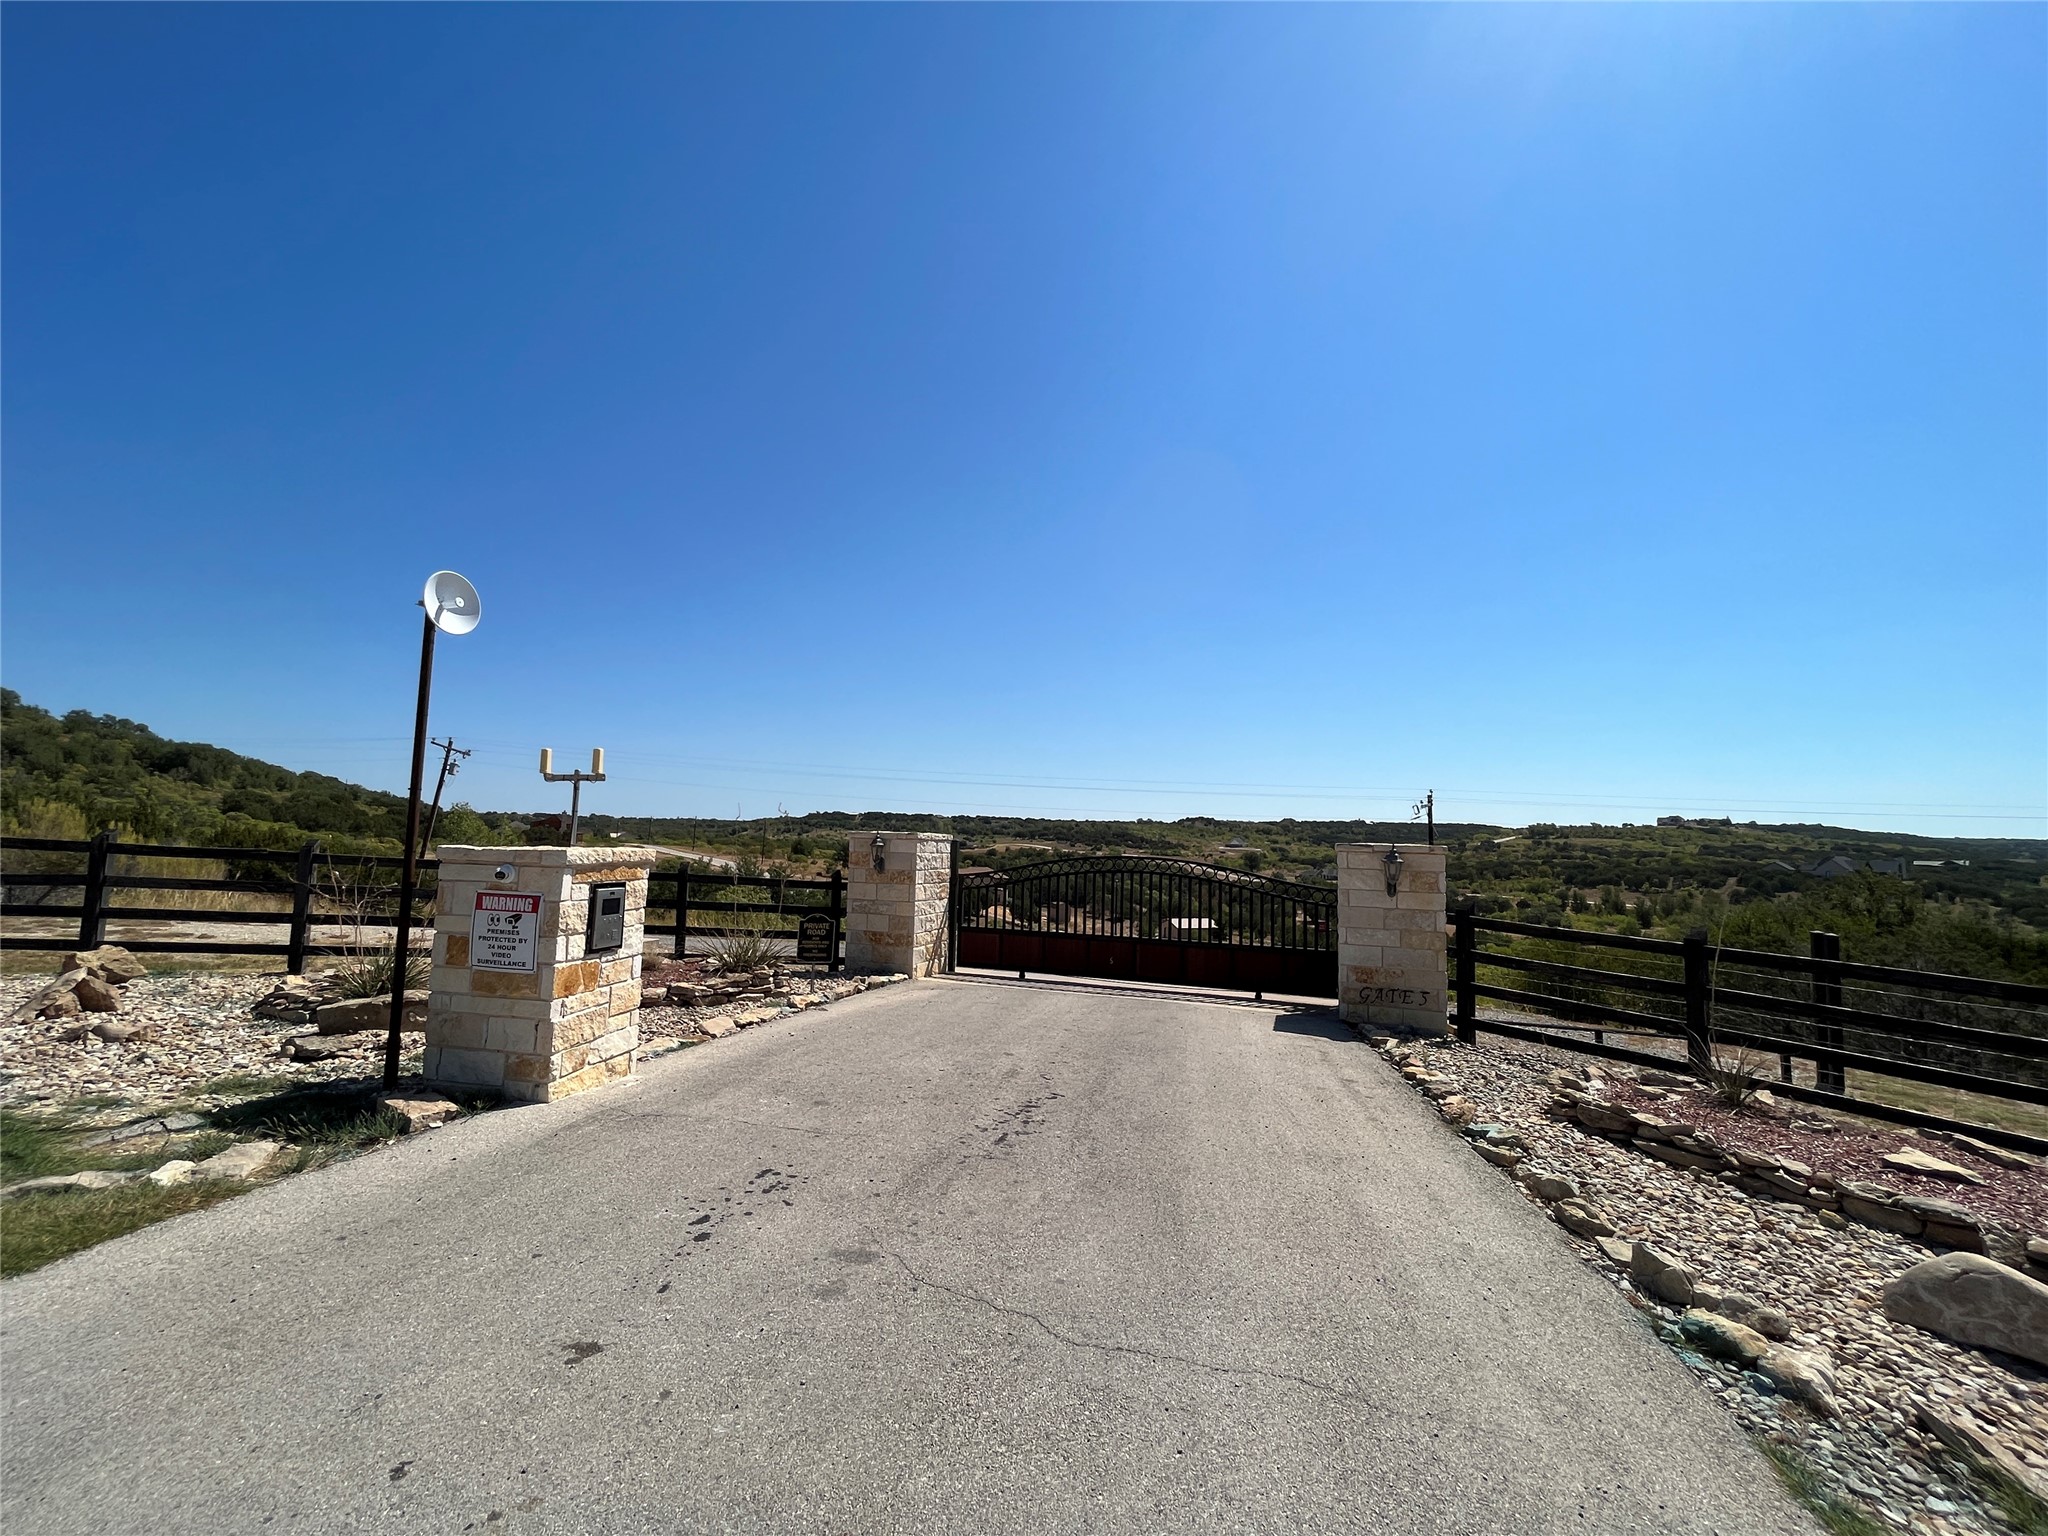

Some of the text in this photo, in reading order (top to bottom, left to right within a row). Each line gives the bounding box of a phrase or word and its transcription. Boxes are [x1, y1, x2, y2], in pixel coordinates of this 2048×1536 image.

[482, 895, 533, 911] WARNING
[477, 958, 526, 967] SURVEILLANCE
[1359, 987, 1431, 1006] GATE 5
